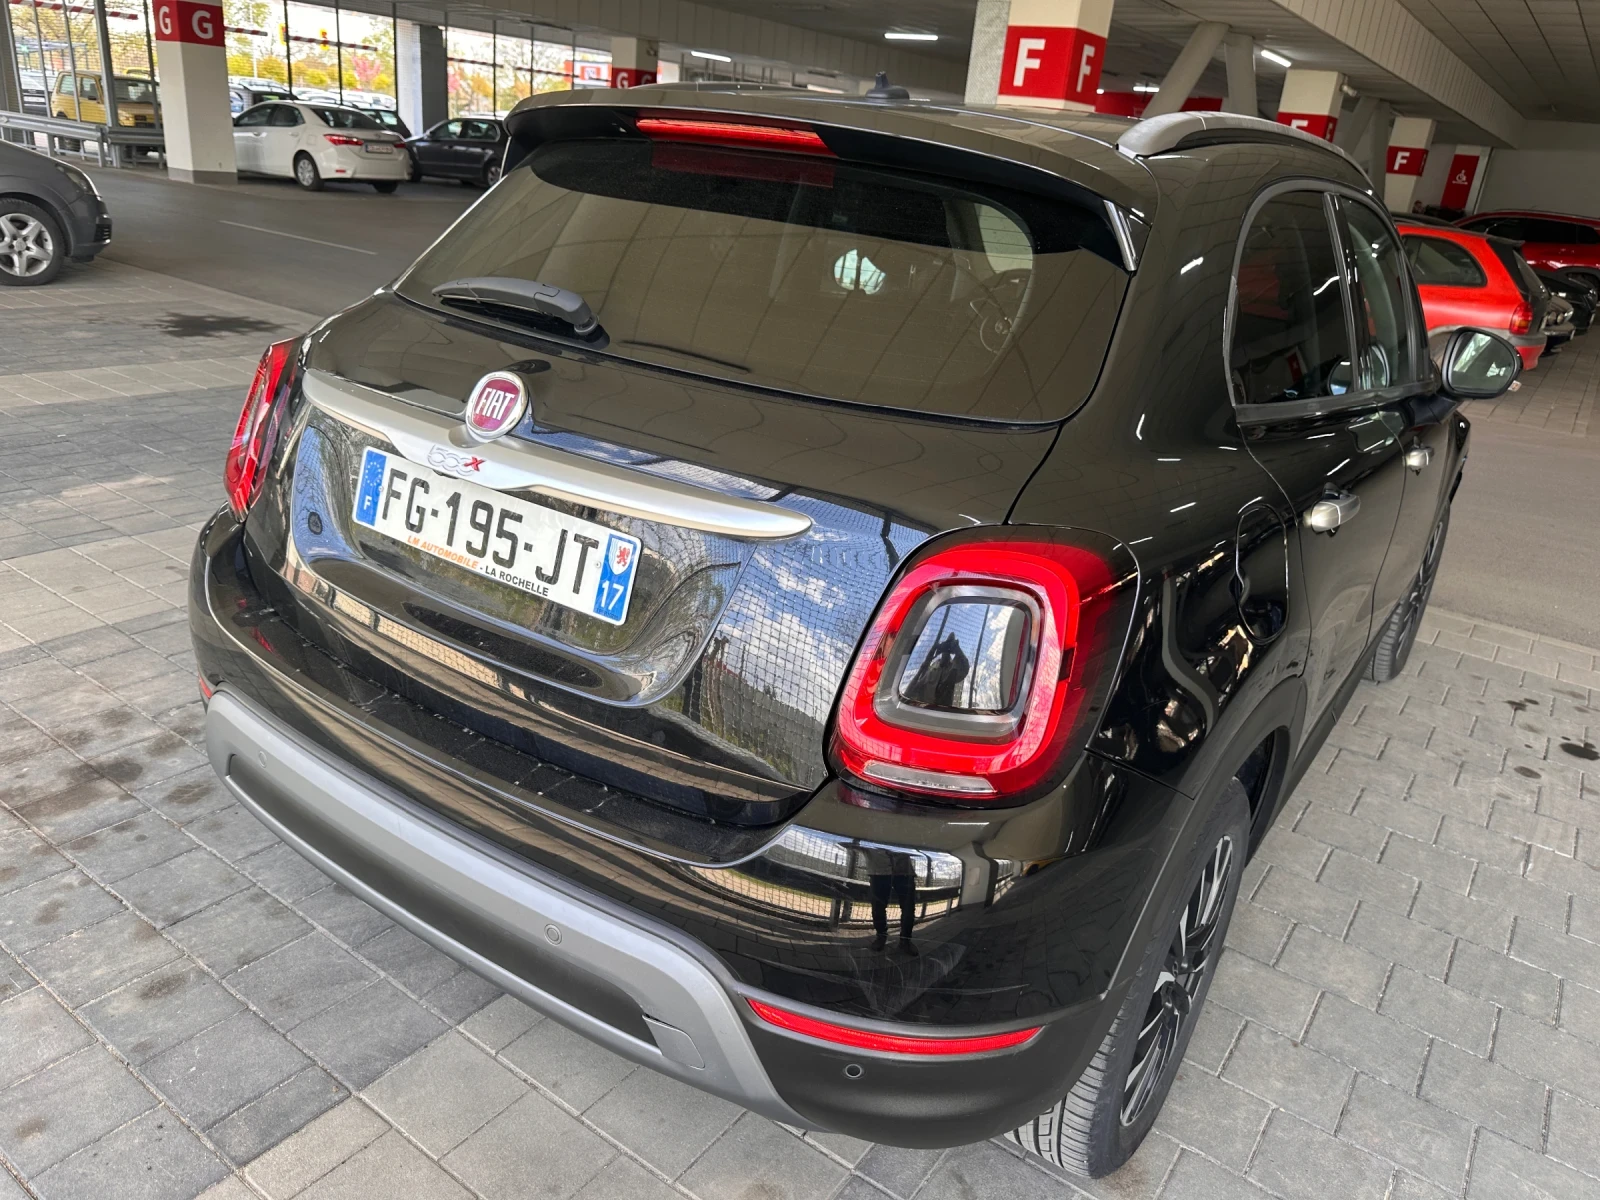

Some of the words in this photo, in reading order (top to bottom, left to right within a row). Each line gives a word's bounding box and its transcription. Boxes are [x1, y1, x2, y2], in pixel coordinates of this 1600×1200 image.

[159, 5, 172, 35] G
[191, 9, 214, 39] G
[1013, 37, 1046, 87] F
[1076, 43, 1096, 92] F
[1393, 151, 1410, 171] F
[475, 387, 516, 421] FIAT
[363, 495, 372, 510] F
[381, 468, 599, 595] FG-195-JT
[407, 535, 421, 547] LM
[420, 542, 479, 569] AUTOMOBILE
[485, 565, 497, 578] LA
[499, 571, 549, 597] ROCHELLE
[601, 580, 625, 611] 17
